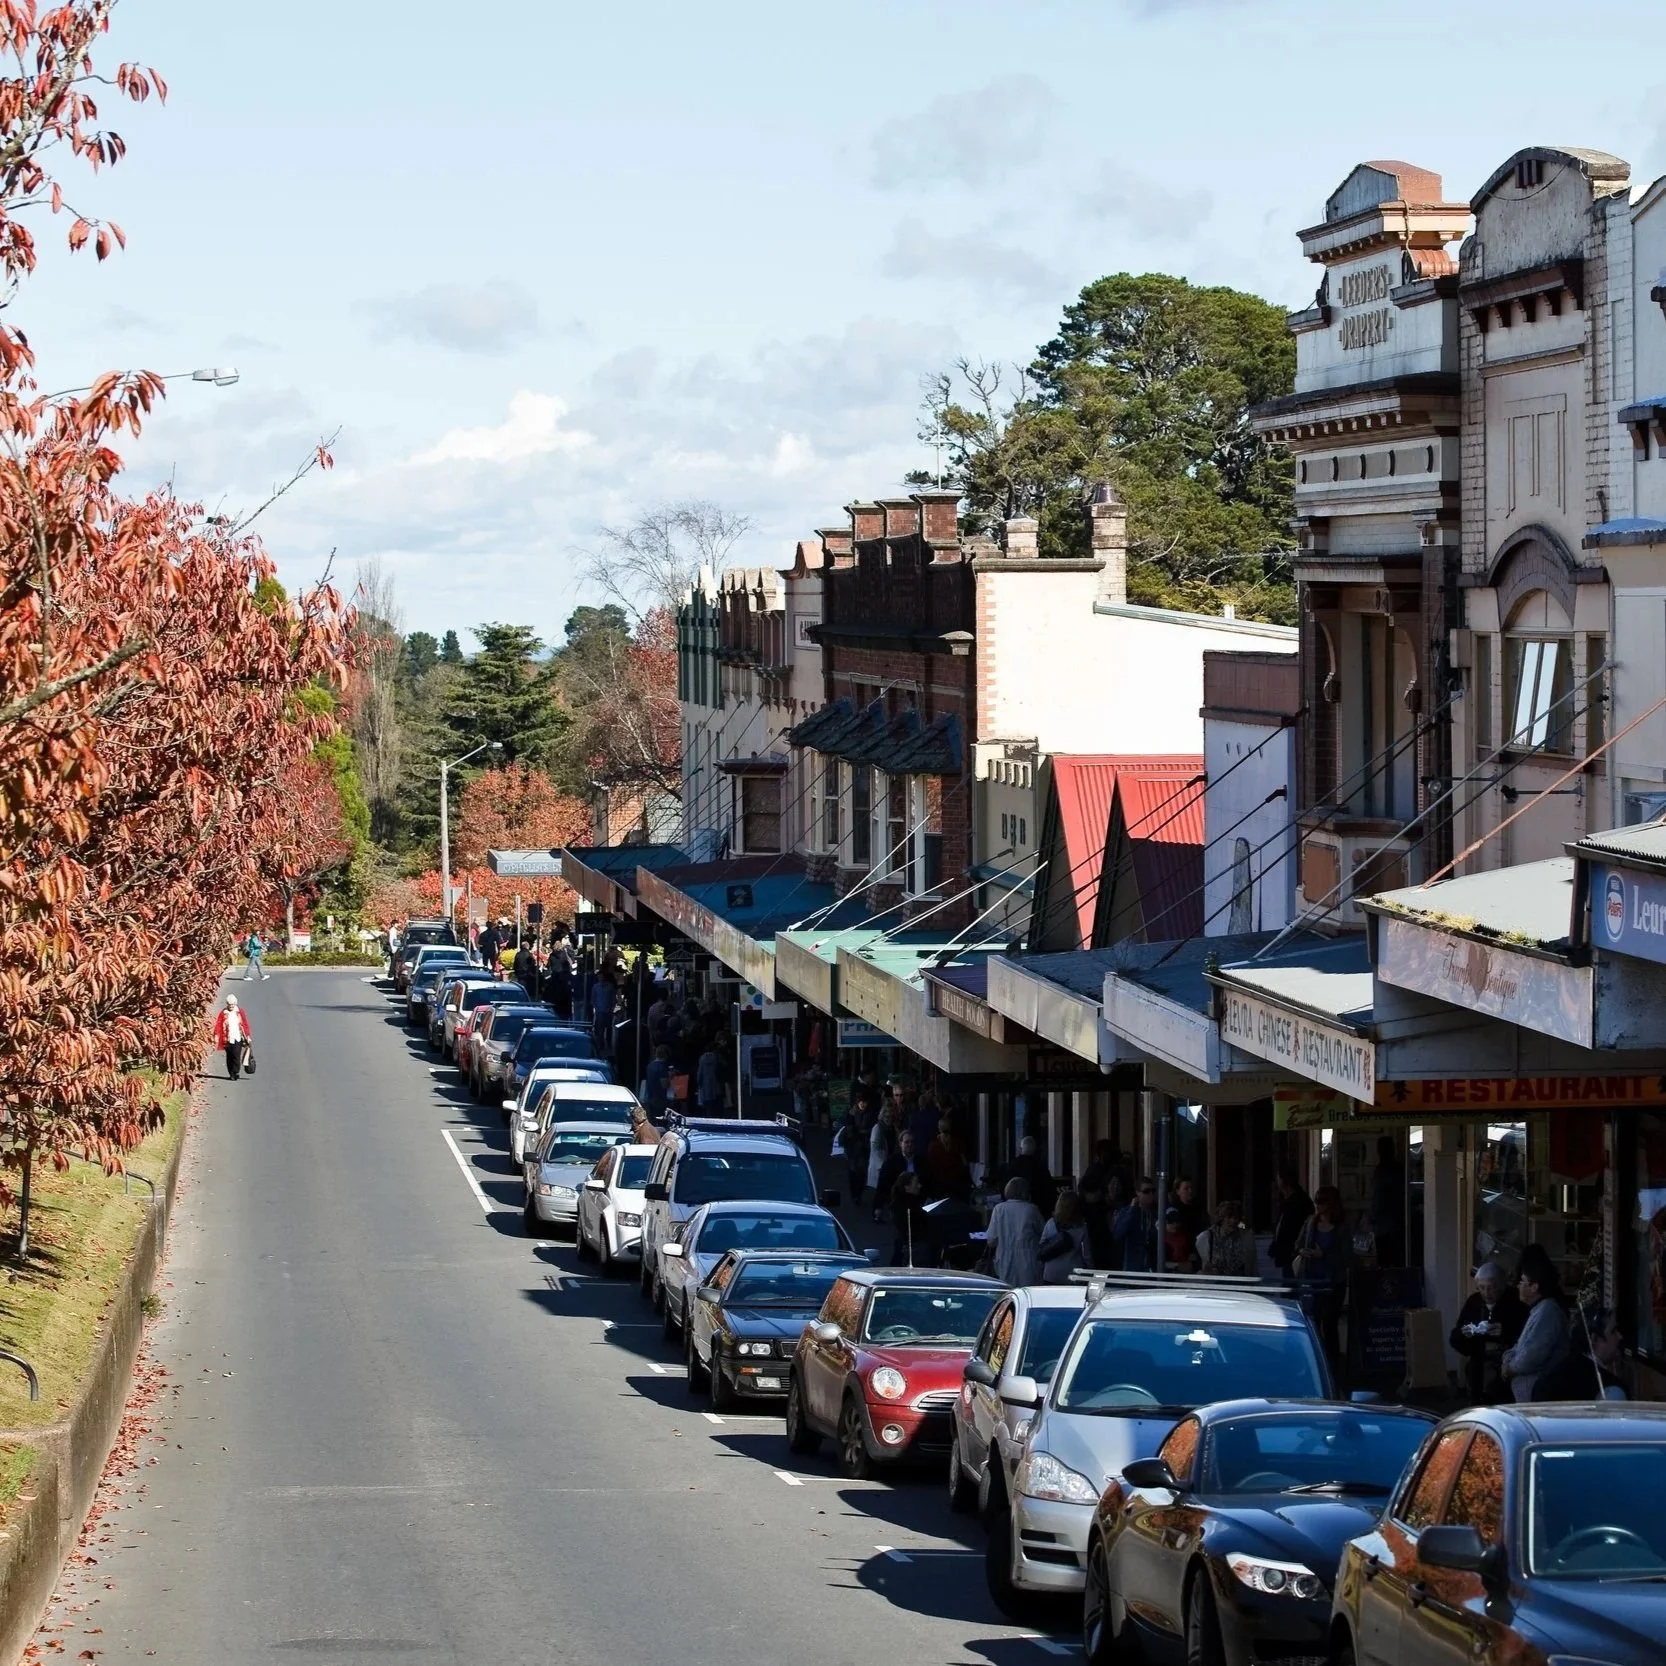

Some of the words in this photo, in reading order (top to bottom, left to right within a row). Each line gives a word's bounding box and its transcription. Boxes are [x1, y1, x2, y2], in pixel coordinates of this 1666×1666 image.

[1342, 309, 1388, 350] DRAPERY
[942, 989, 965, 1019] HEALTH
[966, 1001, 986, 1029] FOODS
[1258, 1009, 1292, 1057] CHINESE
[1422, 1077, 1645, 1103] RESTAURANT
